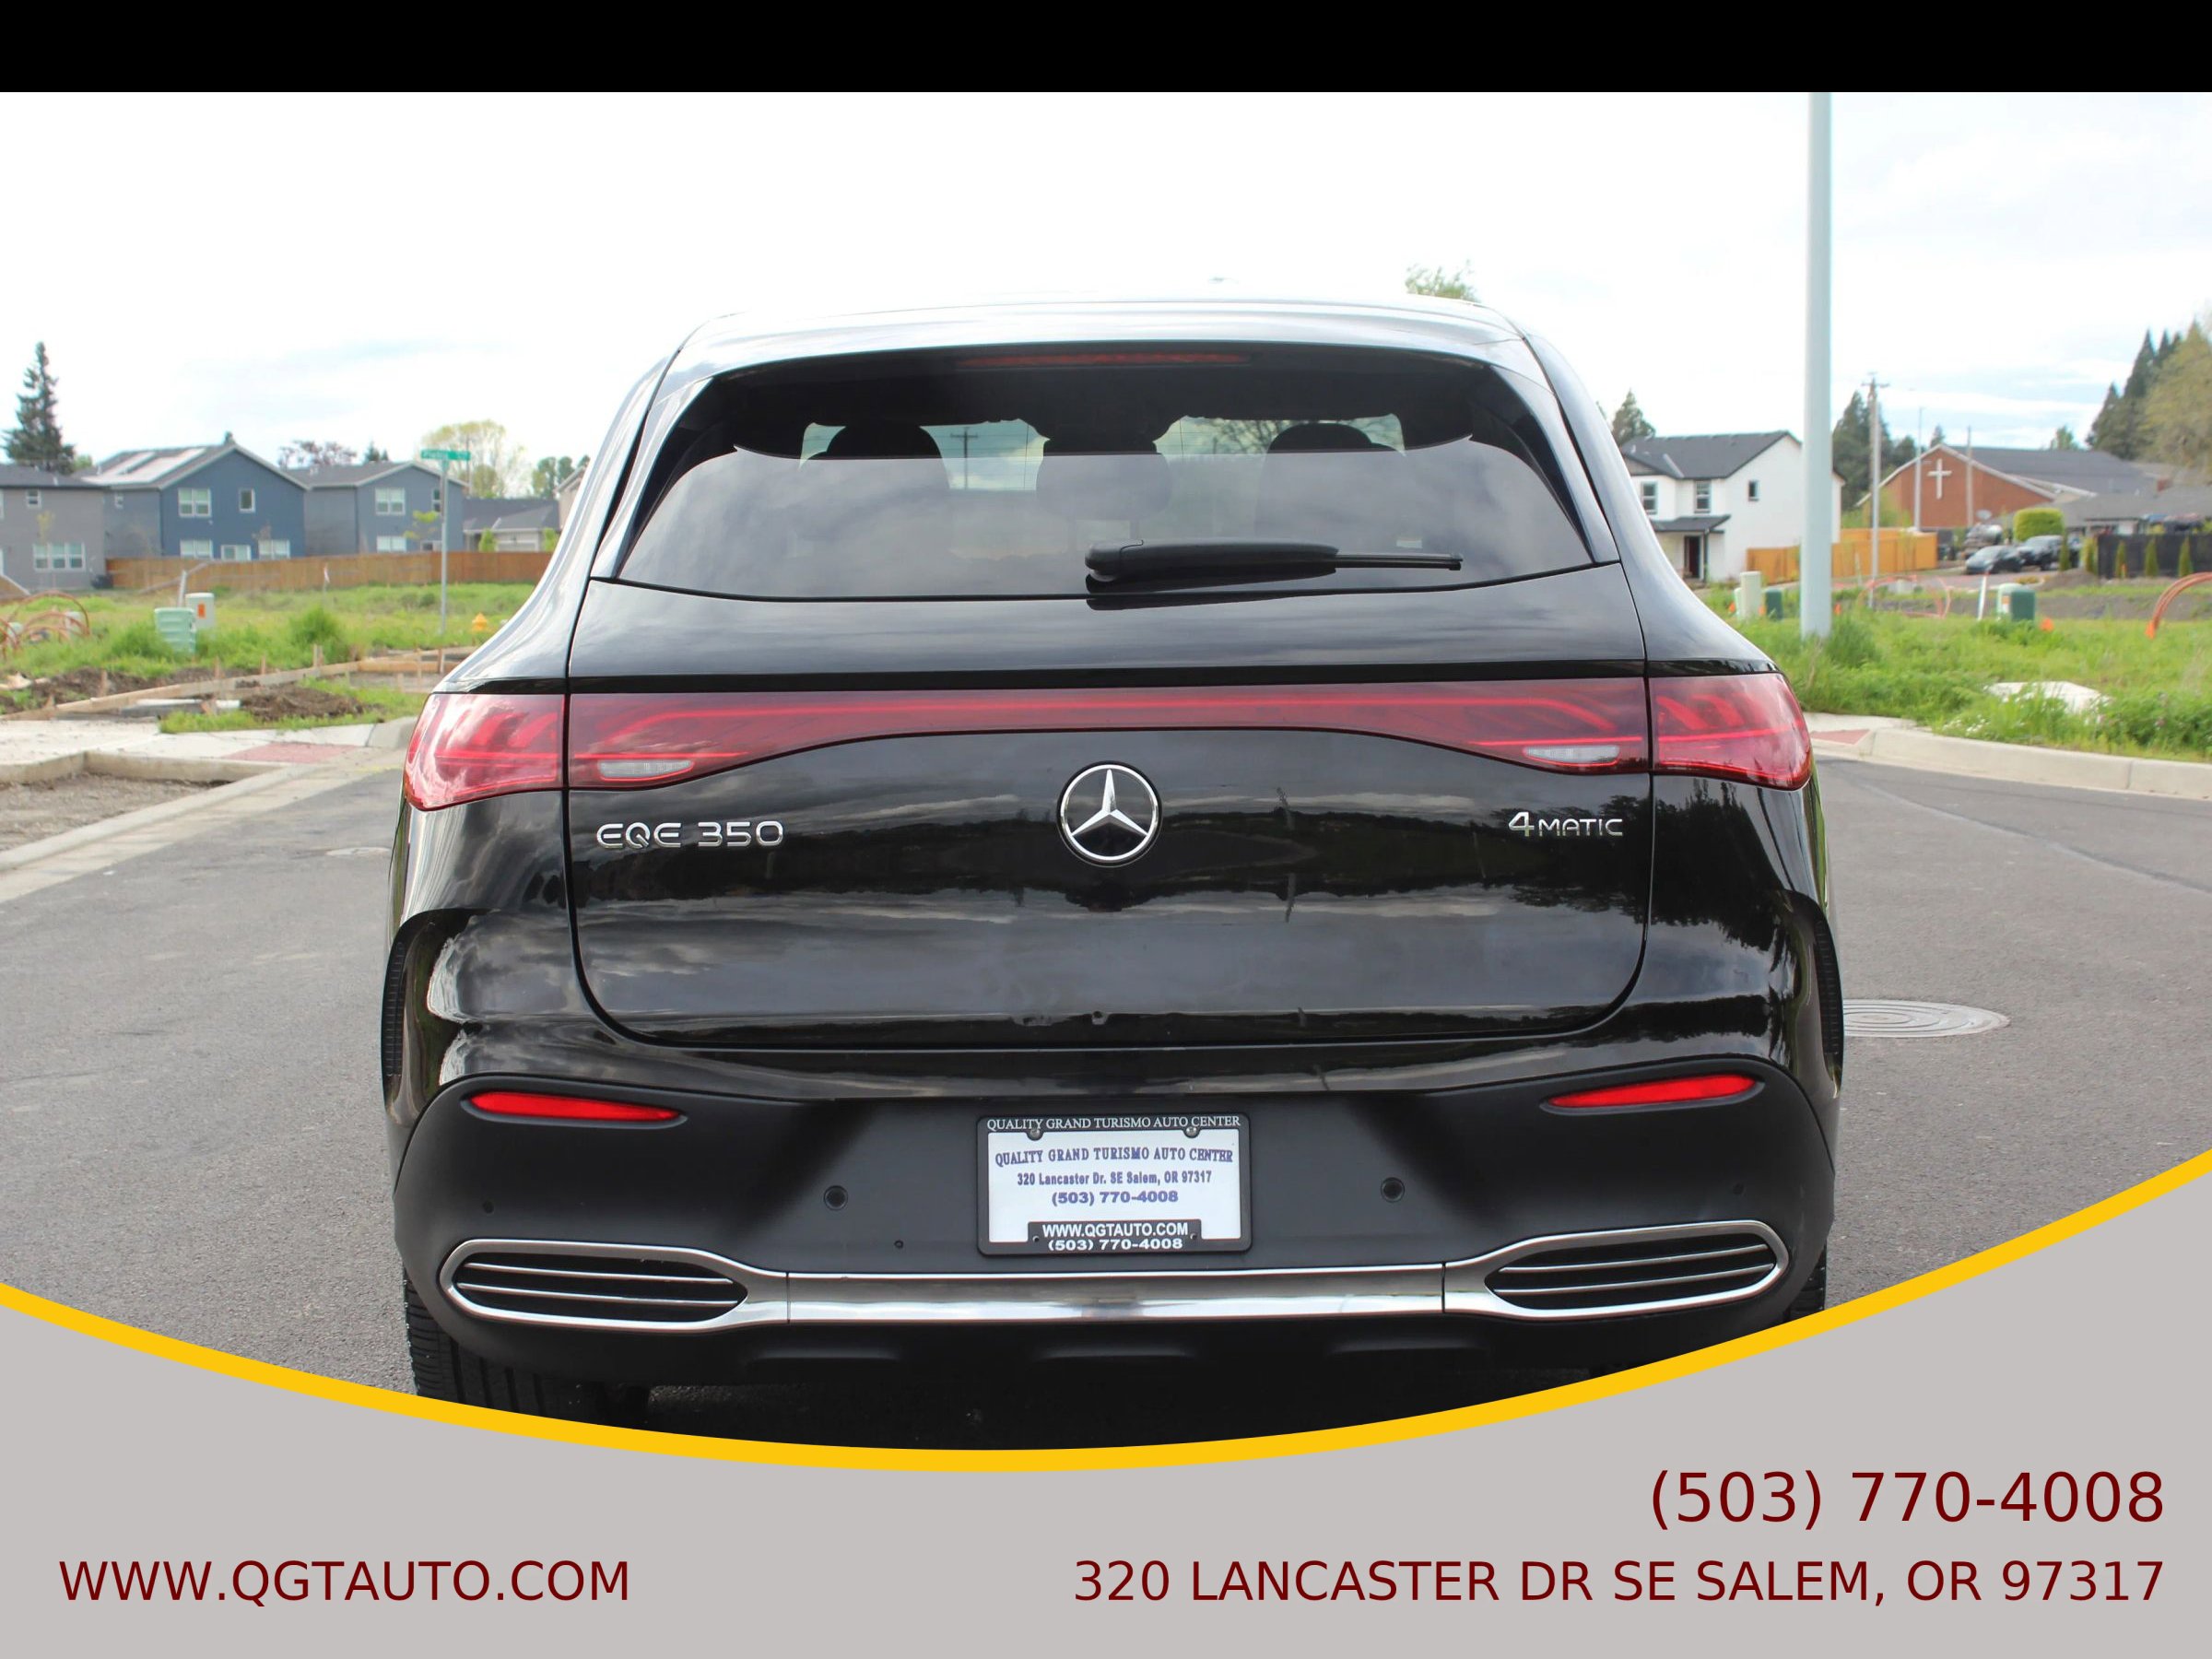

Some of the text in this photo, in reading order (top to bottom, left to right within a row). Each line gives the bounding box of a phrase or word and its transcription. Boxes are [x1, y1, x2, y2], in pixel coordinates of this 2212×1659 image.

[1508, 811, 1623, 837] 4MATIC
[596, 820, 783, 849] EQE 350
[987, 1115, 1241, 1130] QUALITY GRAND TURISMO AUTO CENTER
[994, 1147, 1233, 1167] QUALITY GRAND TURISMO AUTO CENTER
[1018, 1171, 1212, 1185] 320 Lancaster Dr. SE Salem, OR 97317
[1052, 1190, 1179, 1206] (503) 770-4008
[1042, 1222, 1188, 1239] WWW.QGTAUTO.COM
[1048, 1238, 1182, 1252] (503) 770-4008
